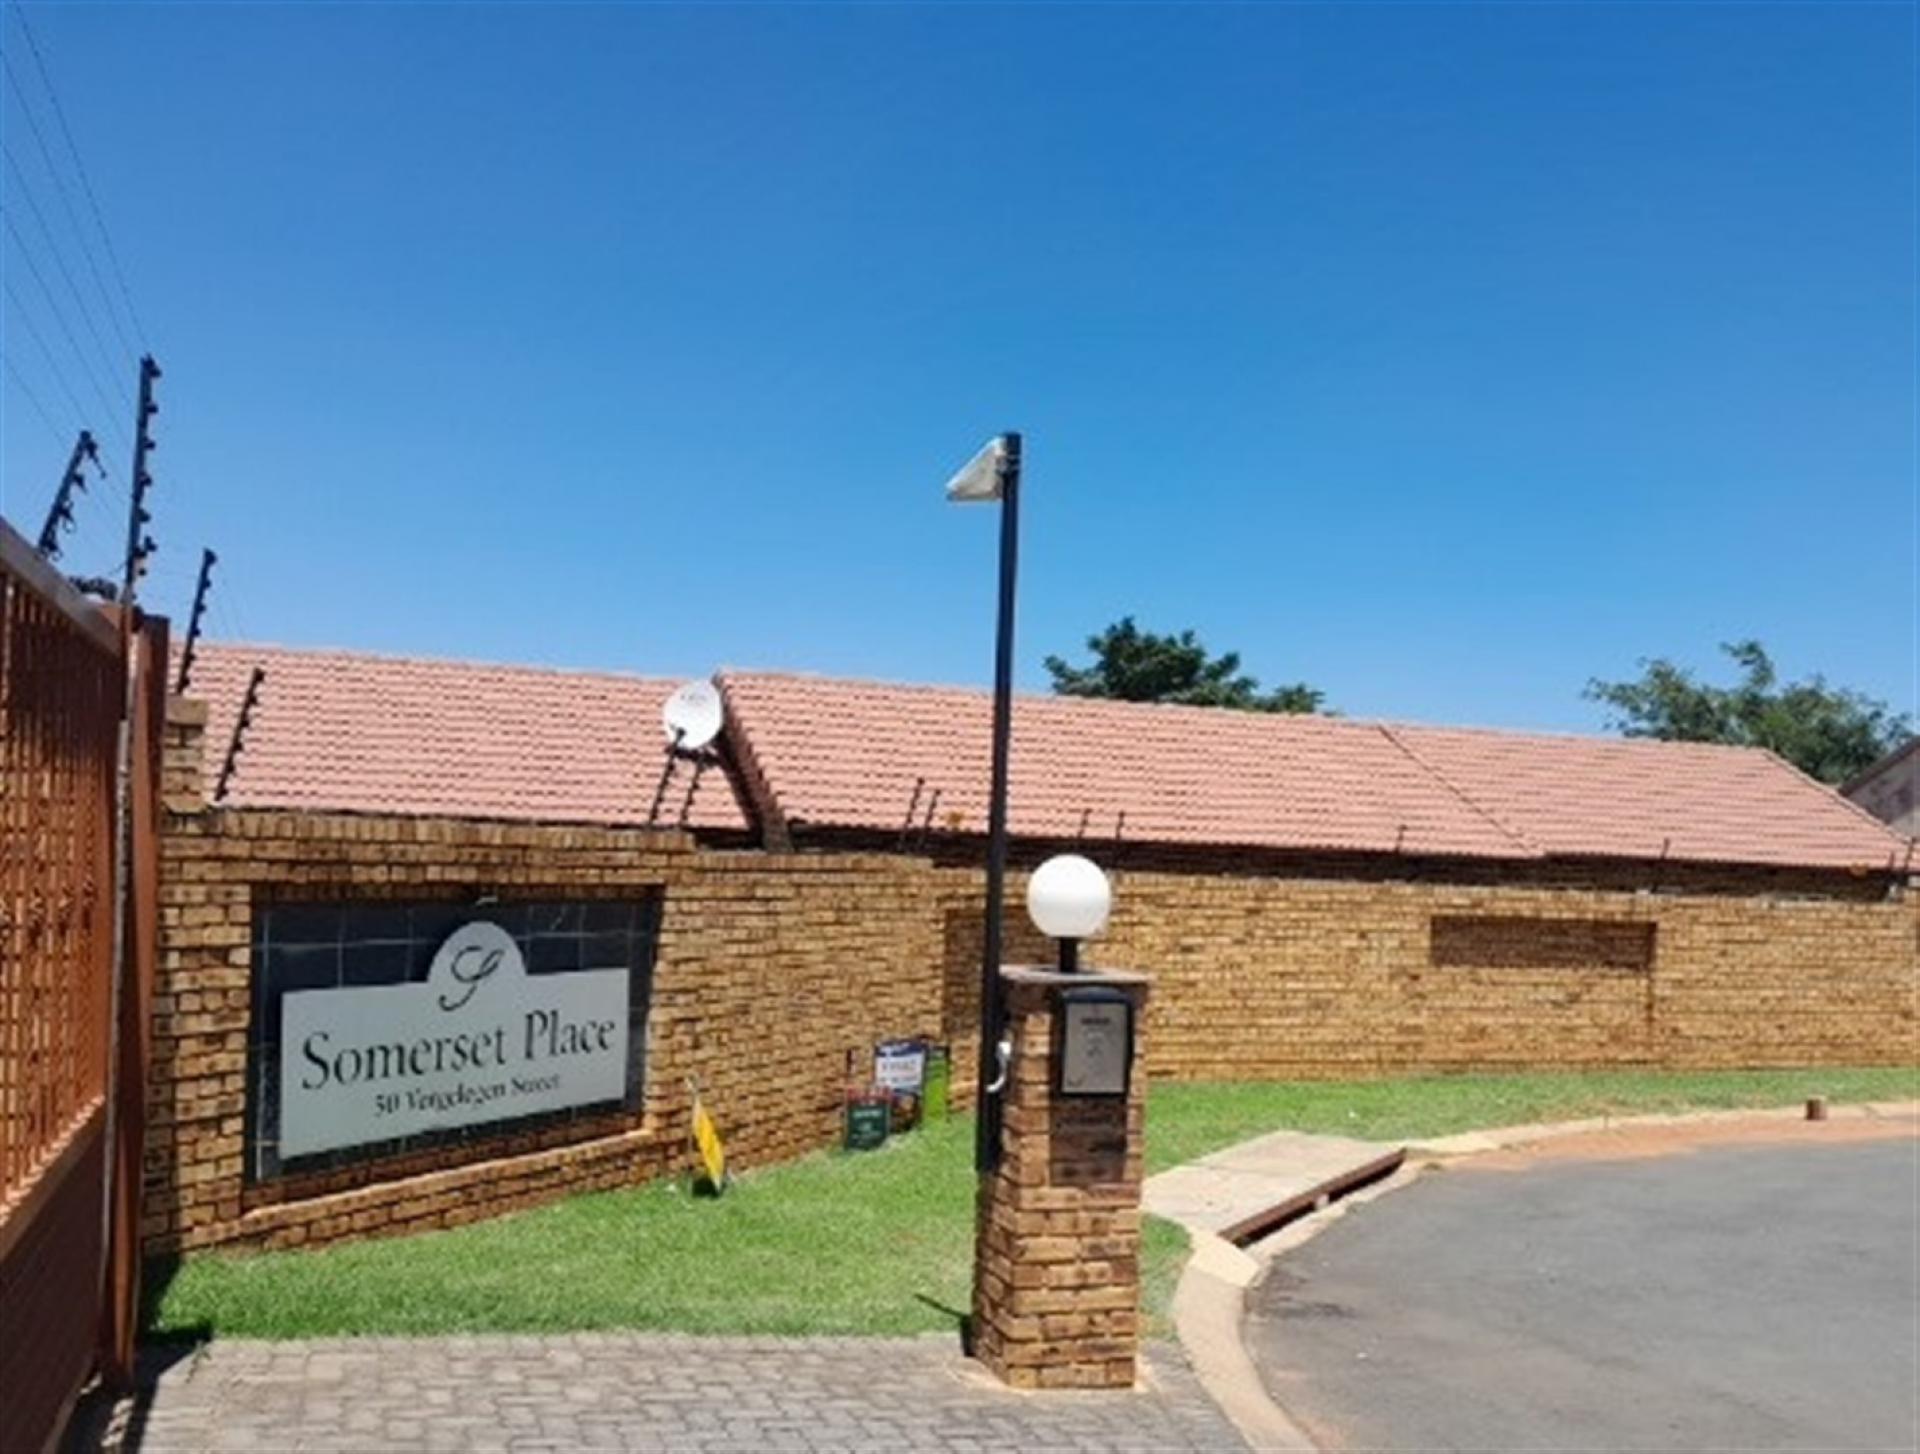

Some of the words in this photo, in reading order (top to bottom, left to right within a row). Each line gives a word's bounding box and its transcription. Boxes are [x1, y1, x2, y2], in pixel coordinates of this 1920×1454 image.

[302, 1030, 507, 1091] Somerset
[525, 1009, 615, 1061] Place
[375, 1093, 400, 1117] 50
[511, 1074, 561, 1096] Street
